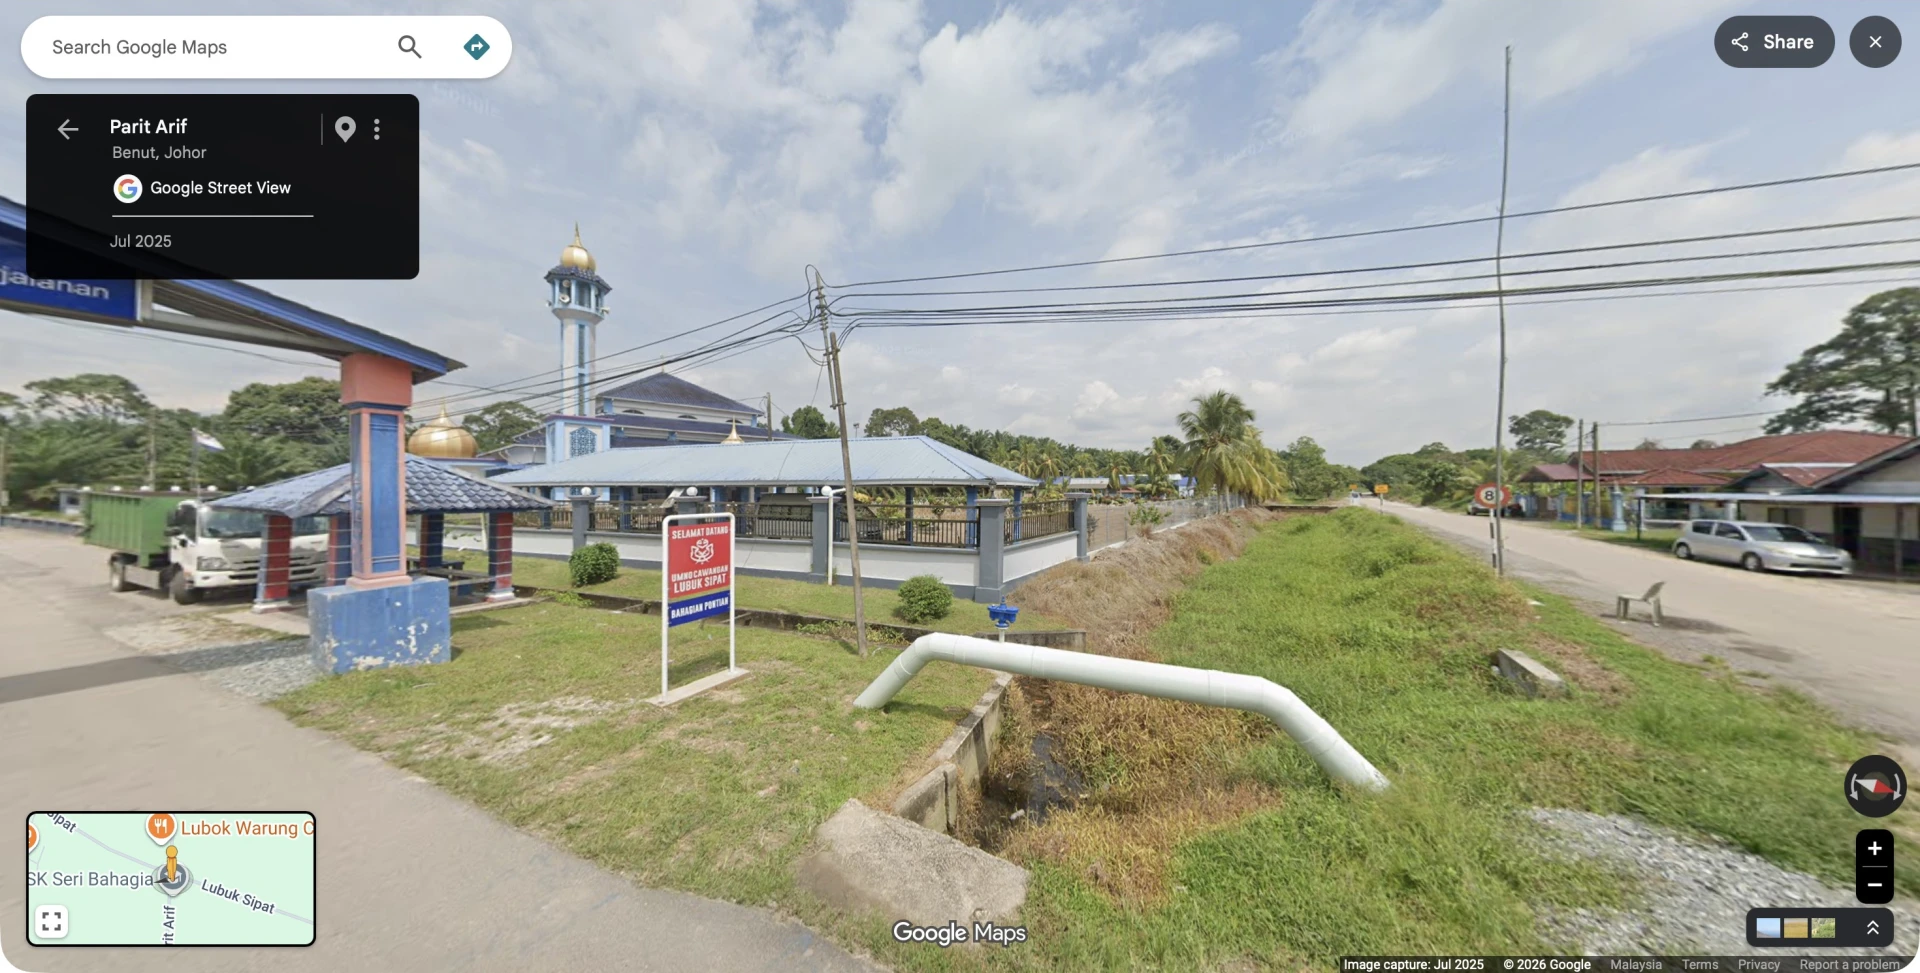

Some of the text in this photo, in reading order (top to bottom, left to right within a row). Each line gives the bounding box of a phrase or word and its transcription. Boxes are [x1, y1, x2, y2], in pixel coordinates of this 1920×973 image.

[672, 526, 728, 539] SELAMAT DATANG
[672, 565, 728, 582] UMNO CAWANGAN
[674, 573, 726, 593] LUBUK SIPAT
[671, 597, 728, 619] BAHAGIAN PONTIAN
